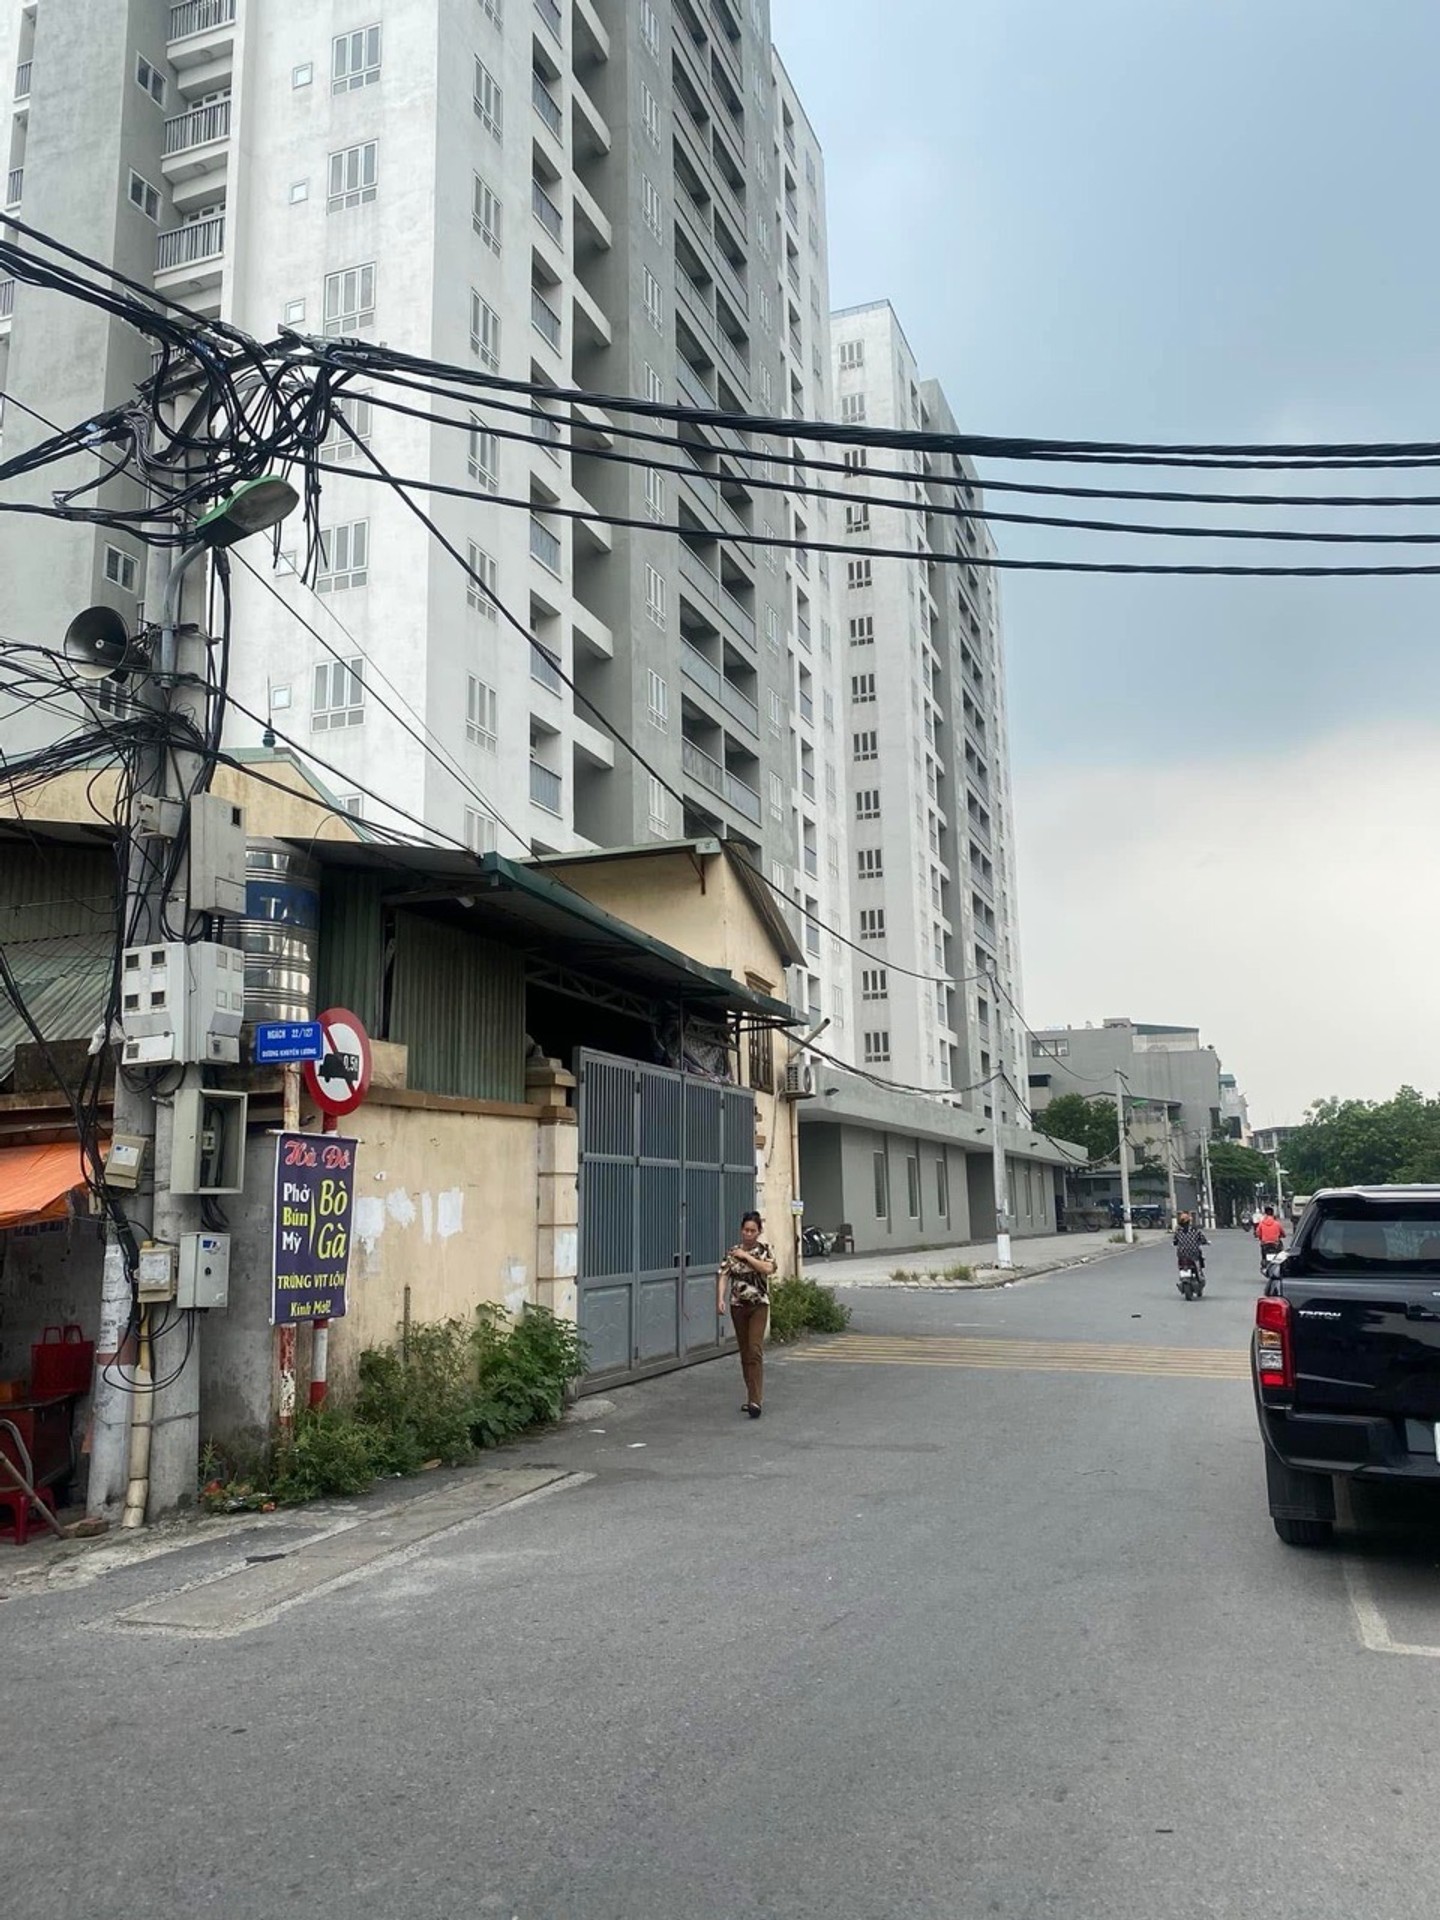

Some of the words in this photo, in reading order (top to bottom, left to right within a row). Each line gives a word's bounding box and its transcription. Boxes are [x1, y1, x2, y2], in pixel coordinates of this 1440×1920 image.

[282, 1182, 311, 1203] Phở
[319, 1179, 348, 1217] Bò
[282, 1206, 309, 1227] Bún
[282, 1231, 302, 1255] Mỳ
[317, 1222, 347, 1260] Gà
[277, 1272, 312, 1290] TRỨNG
[313, 1273, 328, 1290] VỊT
[329, 1271, 345, 1290] LỘN
[290, 1302, 311, 1317] Kính
[1298, 1310, 1342, 1318] TRITON
